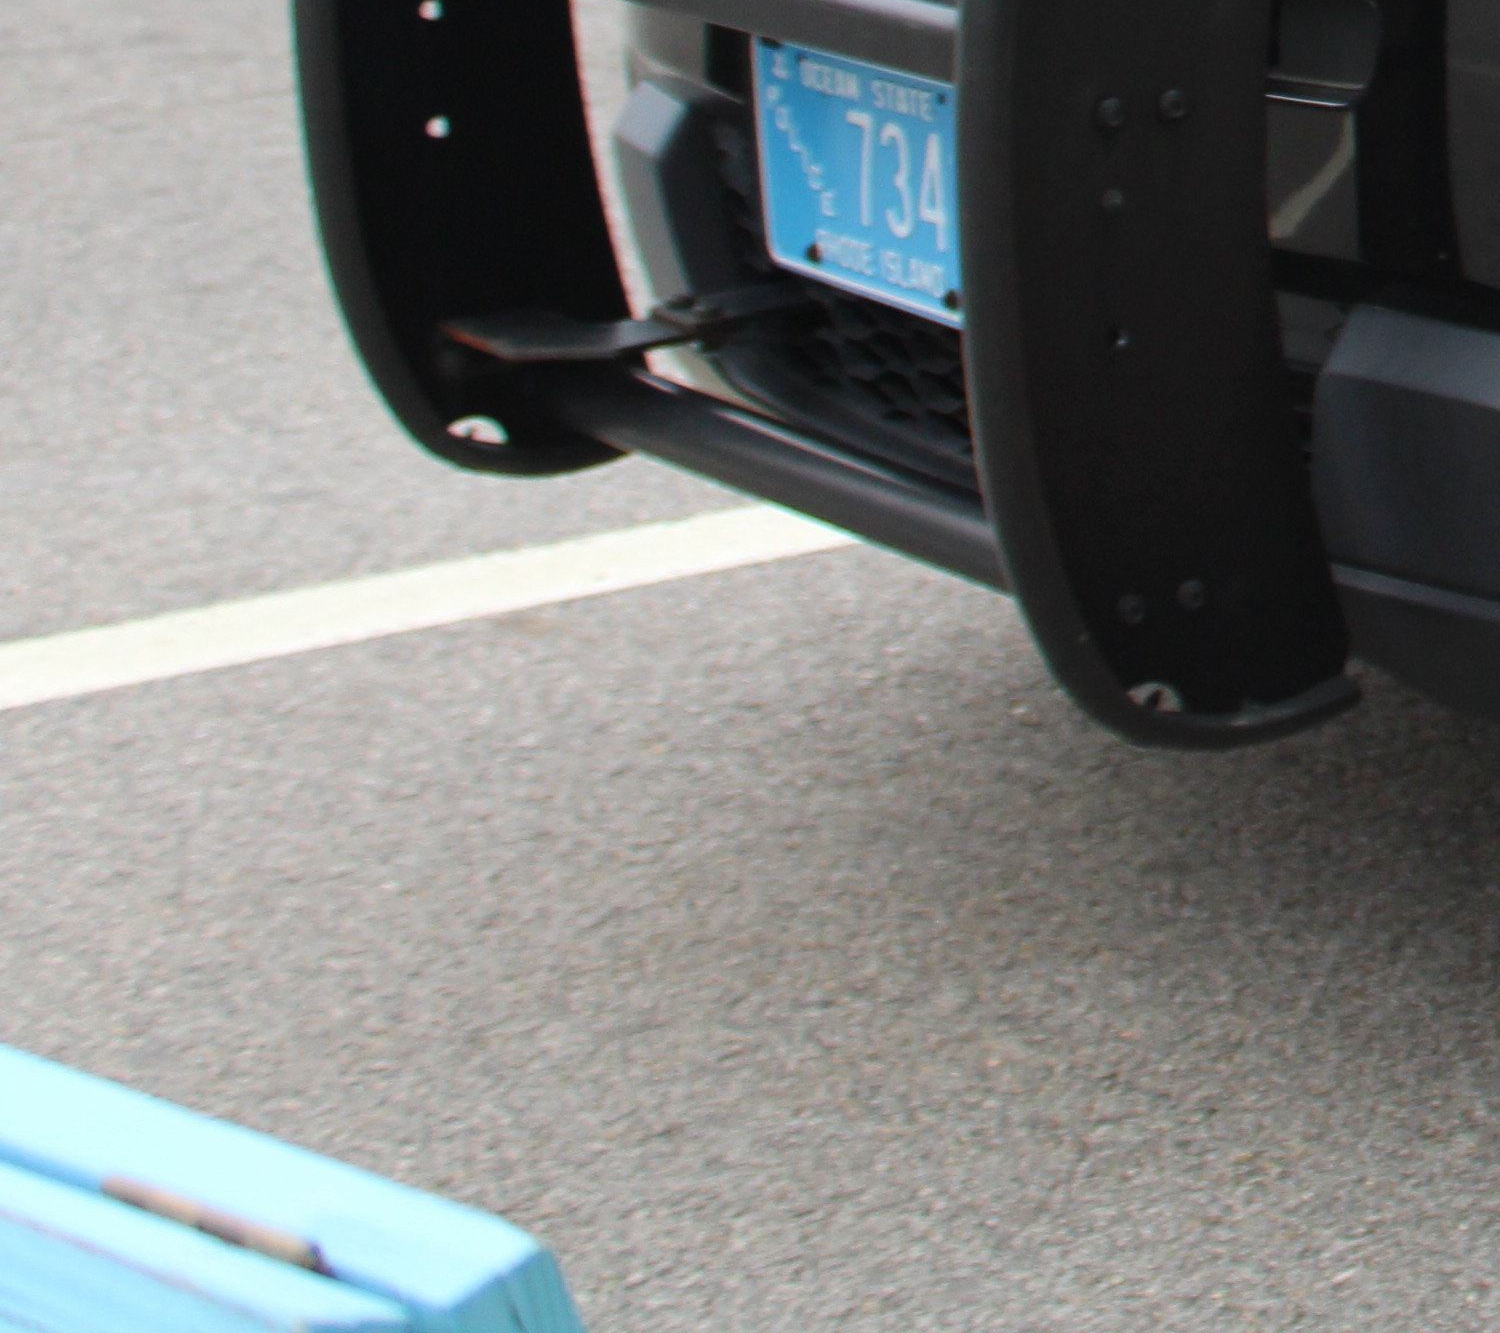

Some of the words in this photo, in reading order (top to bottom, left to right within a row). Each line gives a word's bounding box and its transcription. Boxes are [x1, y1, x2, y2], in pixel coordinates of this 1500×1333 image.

[800, 59, 860, 101] OCEAN
[870, 79, 935, 123] STATE
[765, 85, 838, 218] POLICE
[845, 108, 949, 253] 734
[815, 228, 875, 277] RHODE
[880, 248, 945, 300] ISLAND
